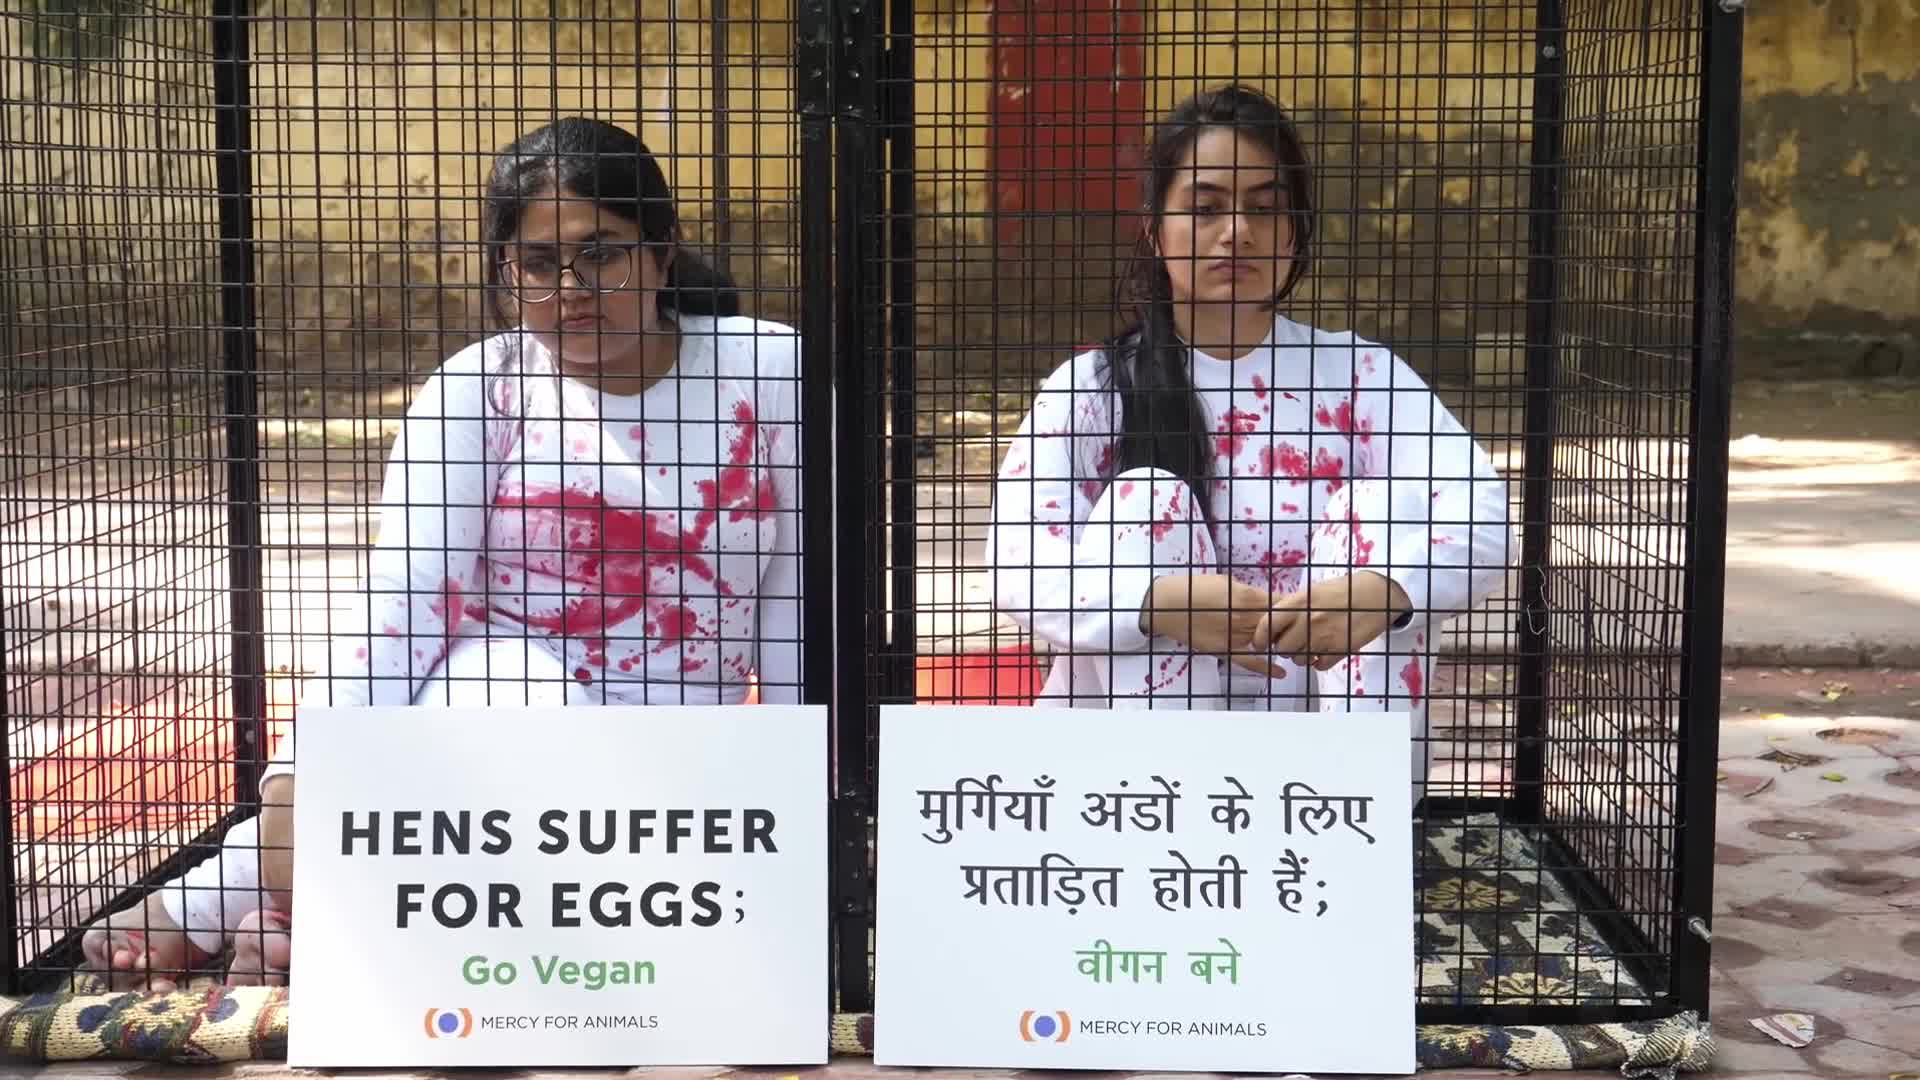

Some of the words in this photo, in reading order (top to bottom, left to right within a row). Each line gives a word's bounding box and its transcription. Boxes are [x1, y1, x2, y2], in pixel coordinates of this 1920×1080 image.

[341, 810, 513, 855] HENS
[537, 808, 778, 855] SUFFER
[916, 774, 1056, 844] मुर्गियाँ
[1080, 775, 1181, 833] अंडों
[1207, 776, 1254, 834] के
[1279, 781, 1375, 844] लिए
[396, 882, 523, 928] FOR
[551, 881, 744, 928] EGGS;
[959, 852, 1124, 915] प्रताड़ित
[1149, 849, 1248, 911] होती
[462, 955, 517, 985] Go
[532, 955, 655, 990] Vegan
[1075, 938, 1167, 984] वीगन
[1187, 937, 1242, 984] बने
[481, 1015, 539, 1030] MERCY
[544, 1015, 578, 1029] FOR
[583, 1014, 658, 1029] ANIMALS
[1080, 1020, 1141, 1035] MERCY
[1146, 1021, 1182, 1036] FOR
[1187, 1021, 1267, 1037] ANIMALS
